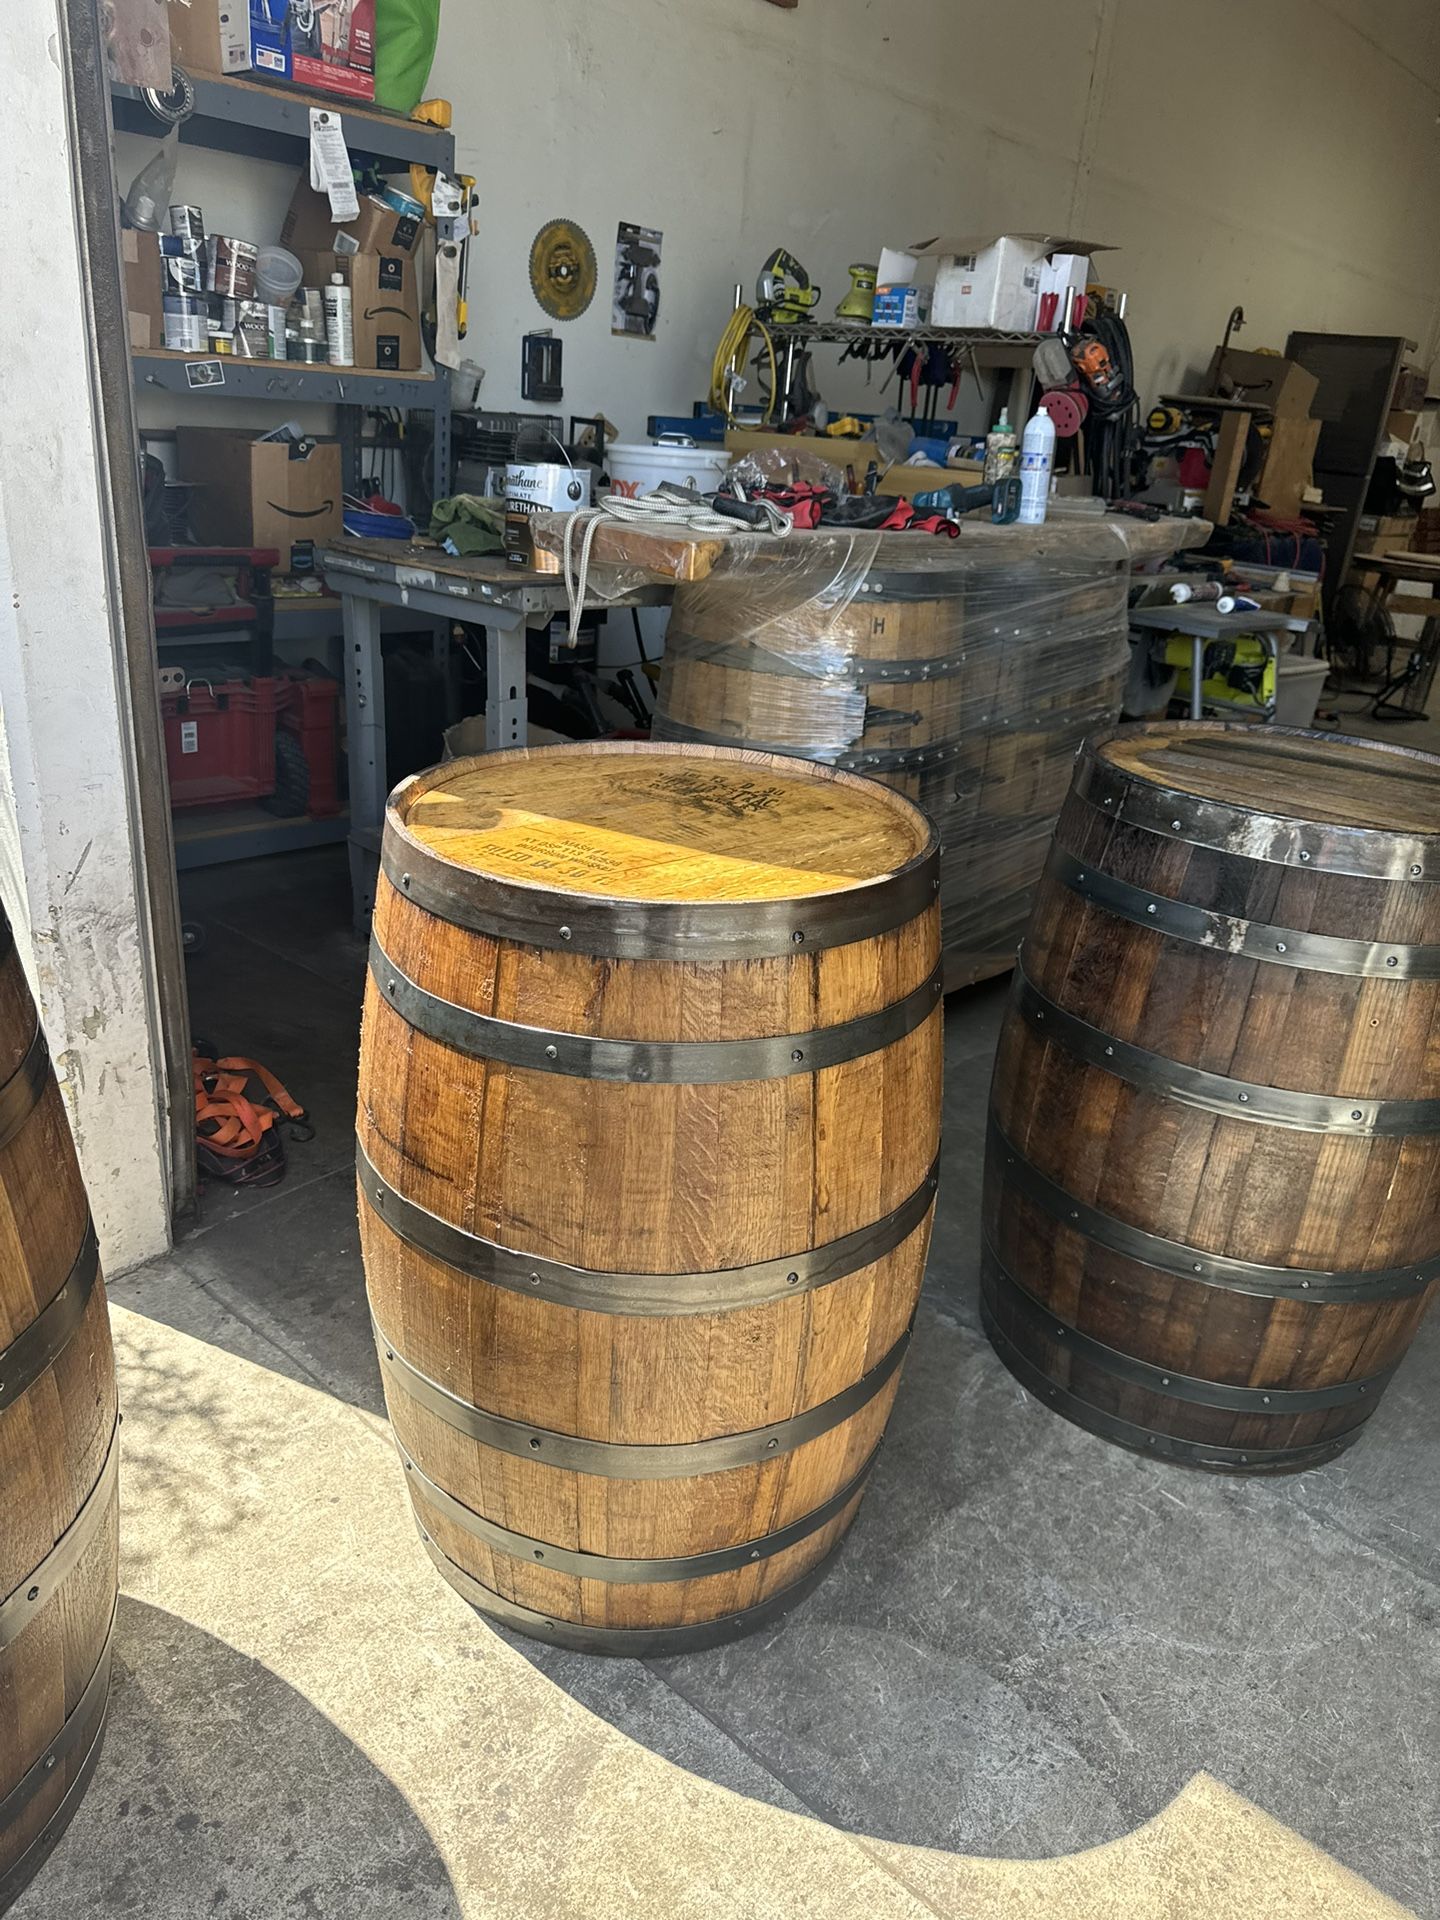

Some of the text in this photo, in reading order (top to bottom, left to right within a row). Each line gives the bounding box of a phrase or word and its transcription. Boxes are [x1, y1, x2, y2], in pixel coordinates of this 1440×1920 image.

[873, 616, 885, 634] H
[481, 844, 533, 862] FILLED
[558, 866, 590, 878] 30
